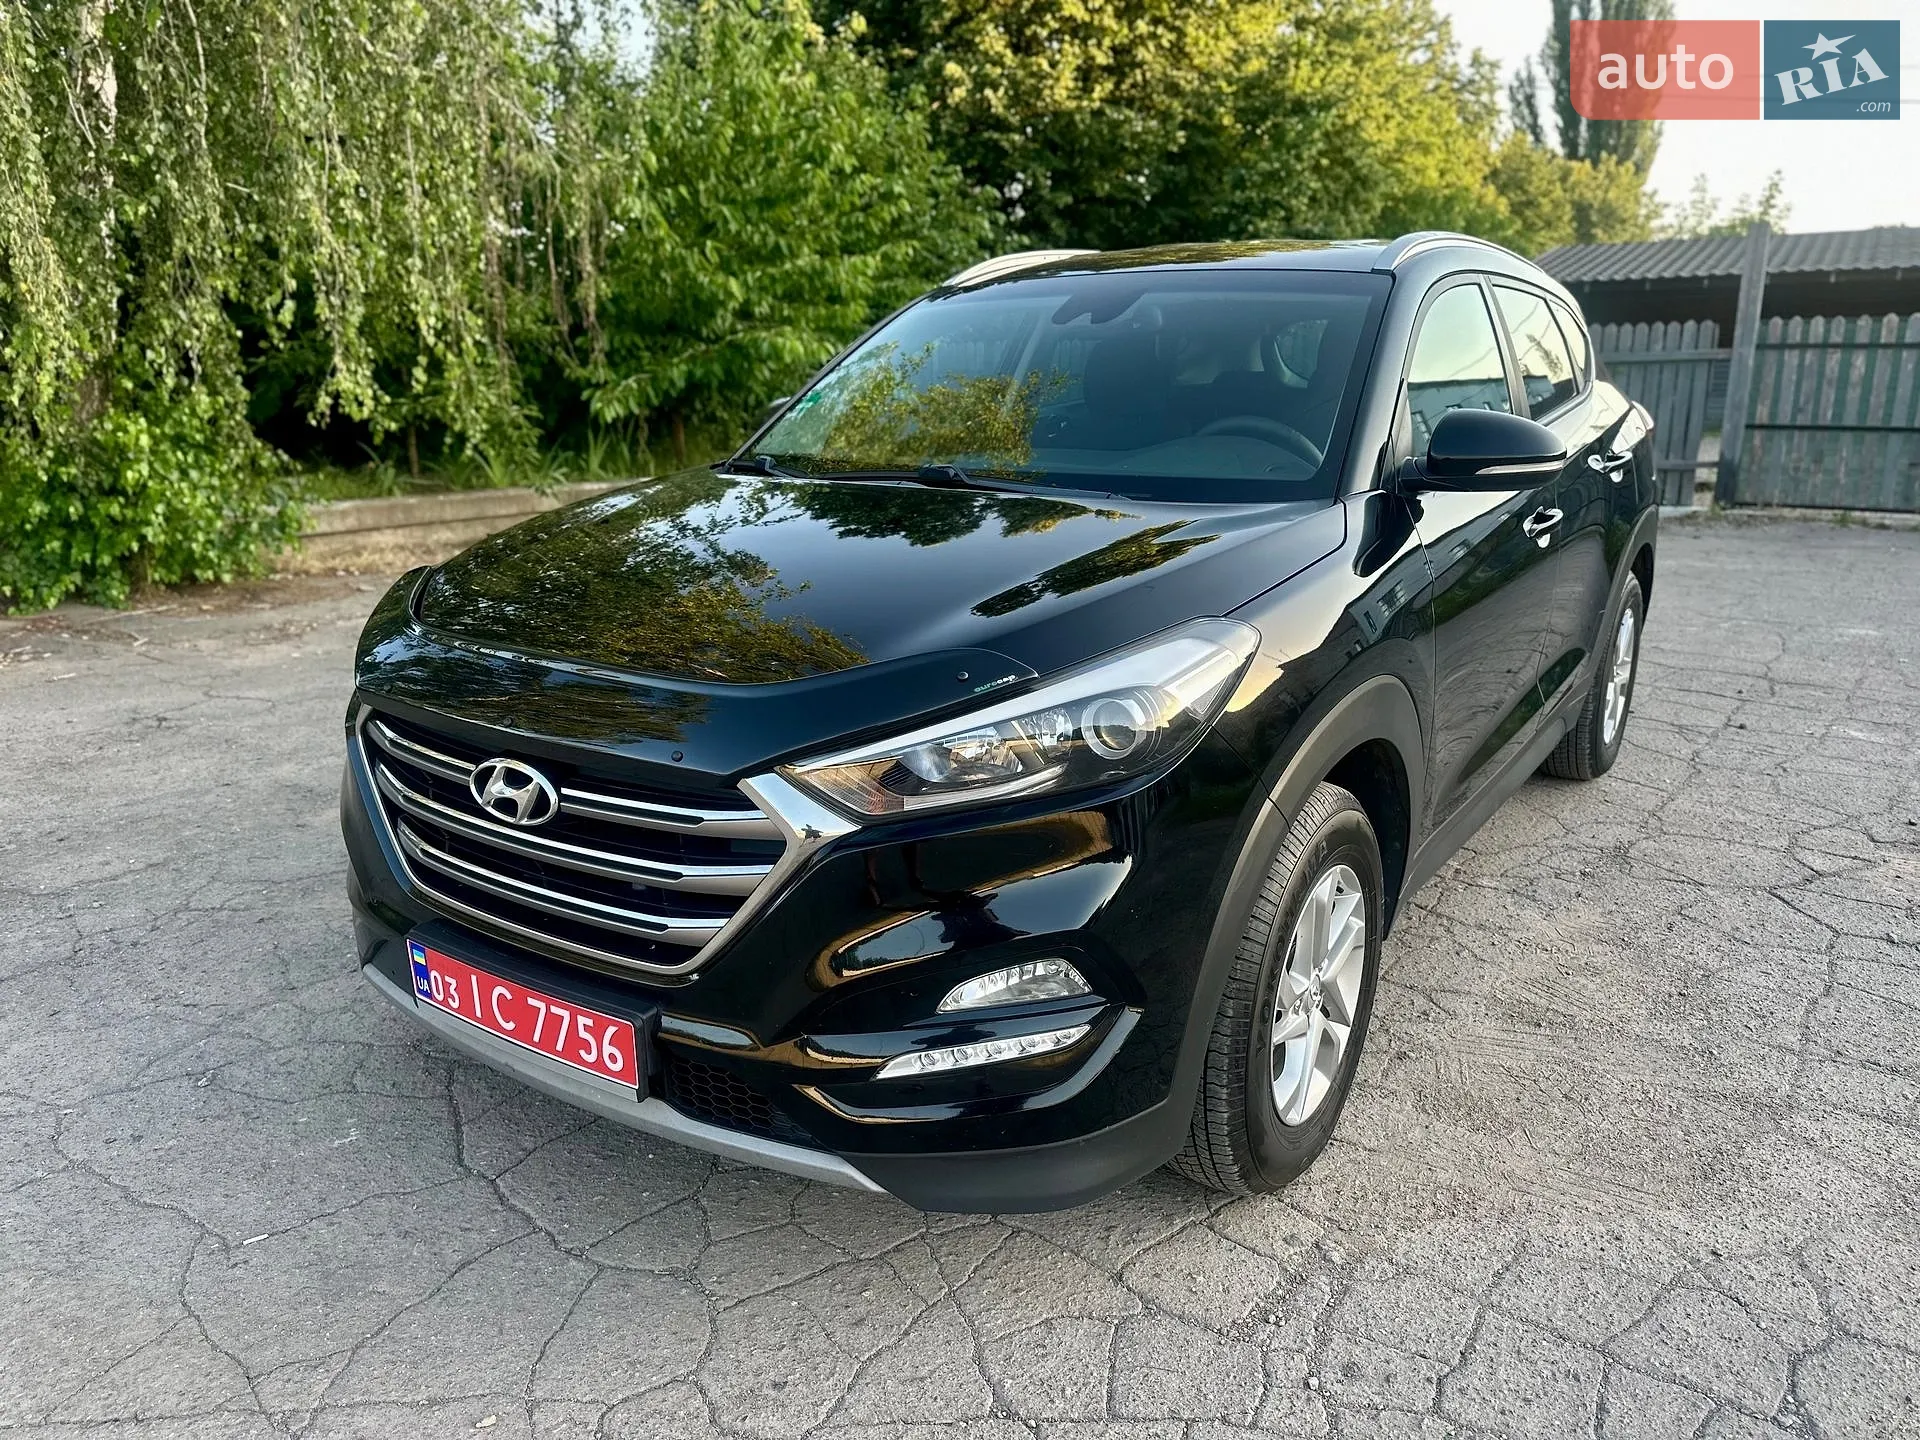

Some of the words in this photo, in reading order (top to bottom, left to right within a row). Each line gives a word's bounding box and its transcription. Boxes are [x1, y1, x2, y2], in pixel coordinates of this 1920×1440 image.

[417, 975, 430, 993] UA
[429, 969, 460, 1009] 03
[527, 996, 624, 1072] 7756
